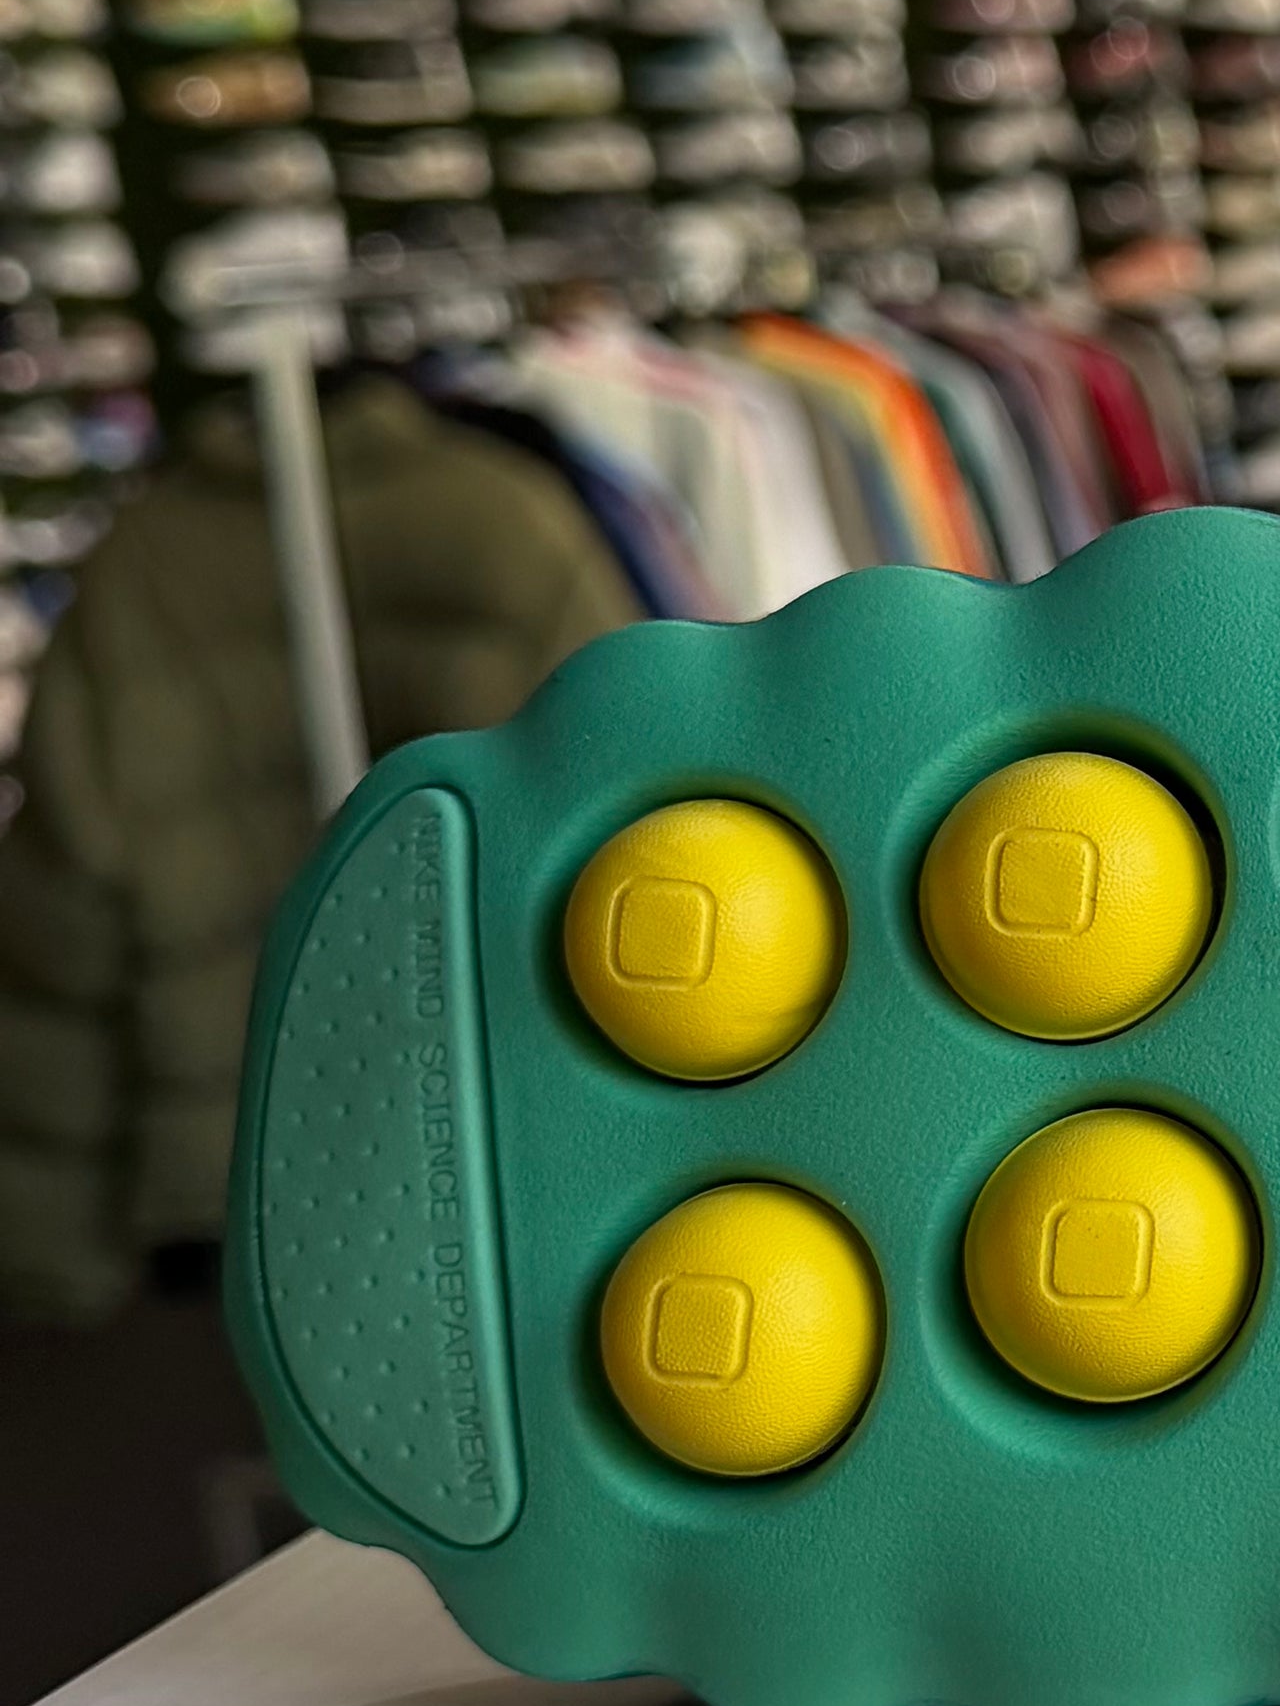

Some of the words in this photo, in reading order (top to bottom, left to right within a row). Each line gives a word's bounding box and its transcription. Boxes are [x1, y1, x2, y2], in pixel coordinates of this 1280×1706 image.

[415, 920, 445, 1019] MIND
[417, 1041, 459, 1223] SCIENCE
[432, 1242, 500, 1508] DEPARTMENT
